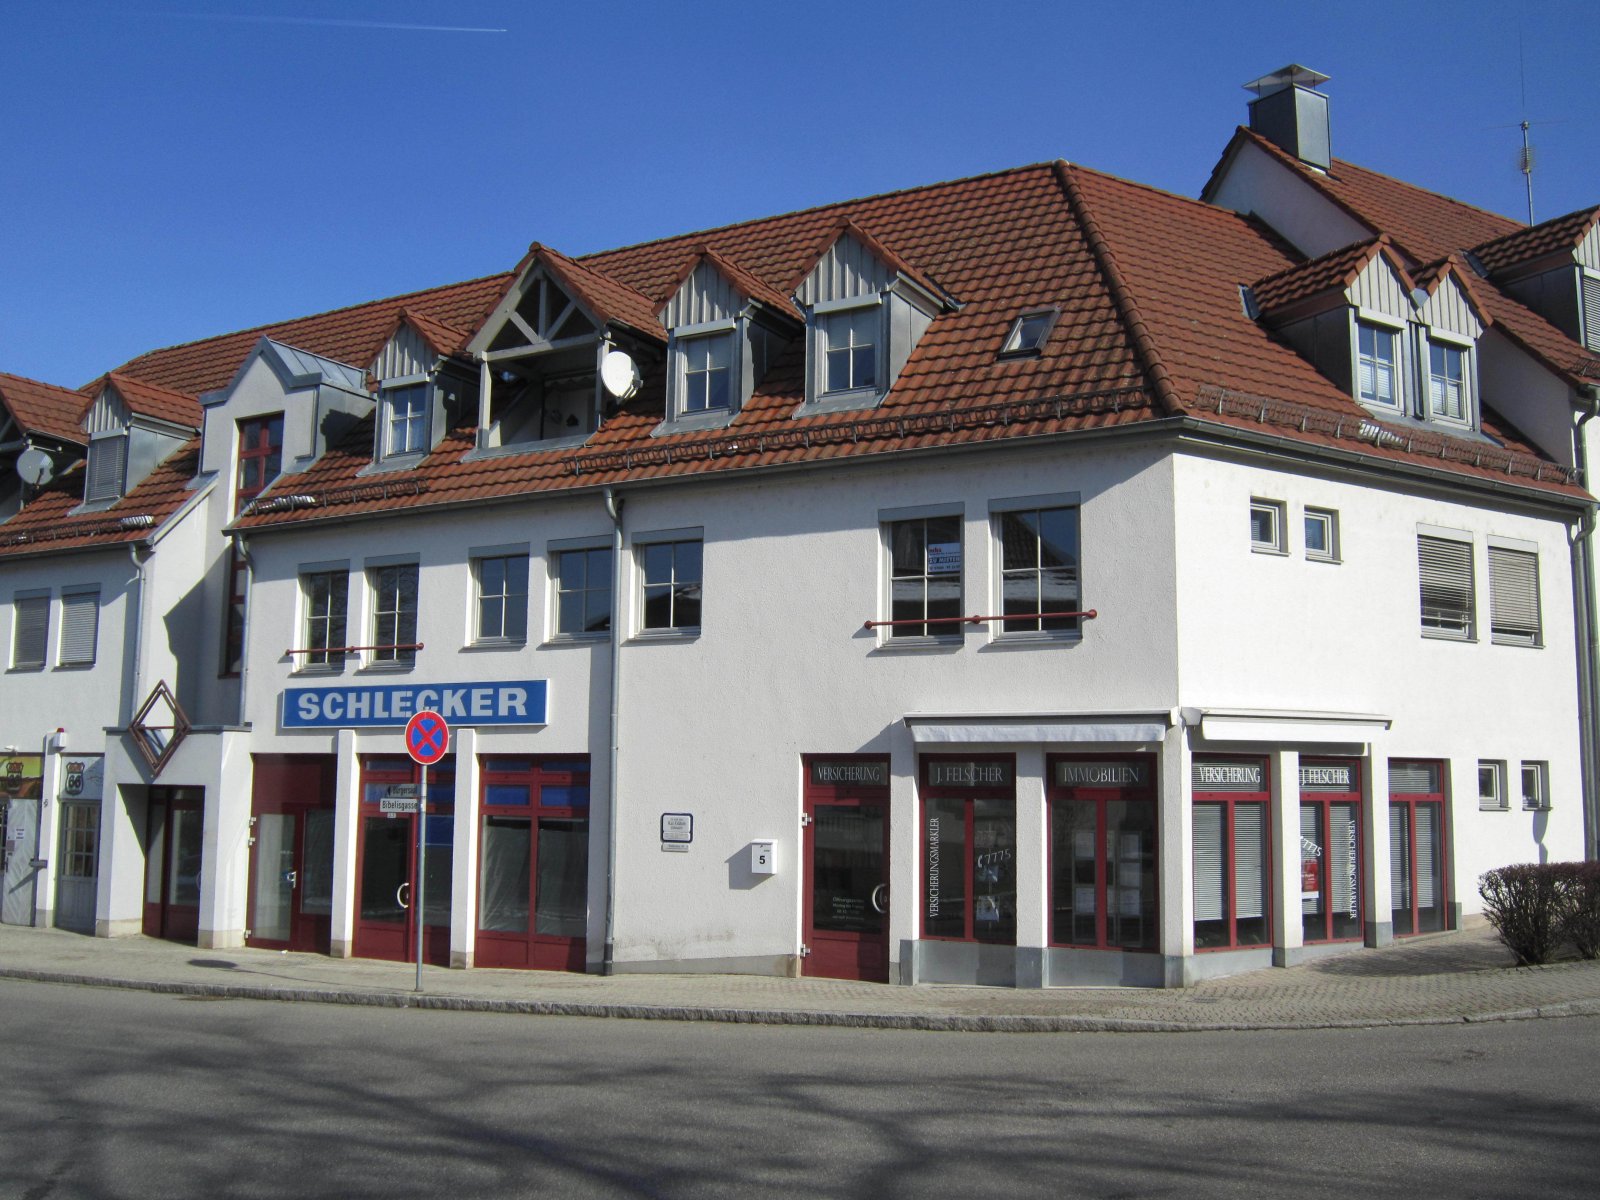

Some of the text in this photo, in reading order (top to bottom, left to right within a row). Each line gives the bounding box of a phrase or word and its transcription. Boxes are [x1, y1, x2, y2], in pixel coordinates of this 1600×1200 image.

[298, 687, 528, 721] SCHLECKER
[68, 775, 81, 788] 66
[818, 766, 880, 782] VERSICHERUNG
[936, 766, 1003, 784] J. FELSCHER
[1064, 767, 1139, 783] IMMOBILIEN
[1199, 767, 1260, 783] VERSICHERUNG
[1301, 769, 1350, 785] J. FELSCHER
[382, 800, 418, 811] Bibelisgasse
[1303, 838, 1322, 857] 7775
[759, 855, 766, 865] 5
[984, 848, 1011, 864] 7775
[929, 817, 939, 917] VERSICHERUNGSMARKLER
[1348, 820, 1357, 919] VERSICHERUNGSMARKLER
